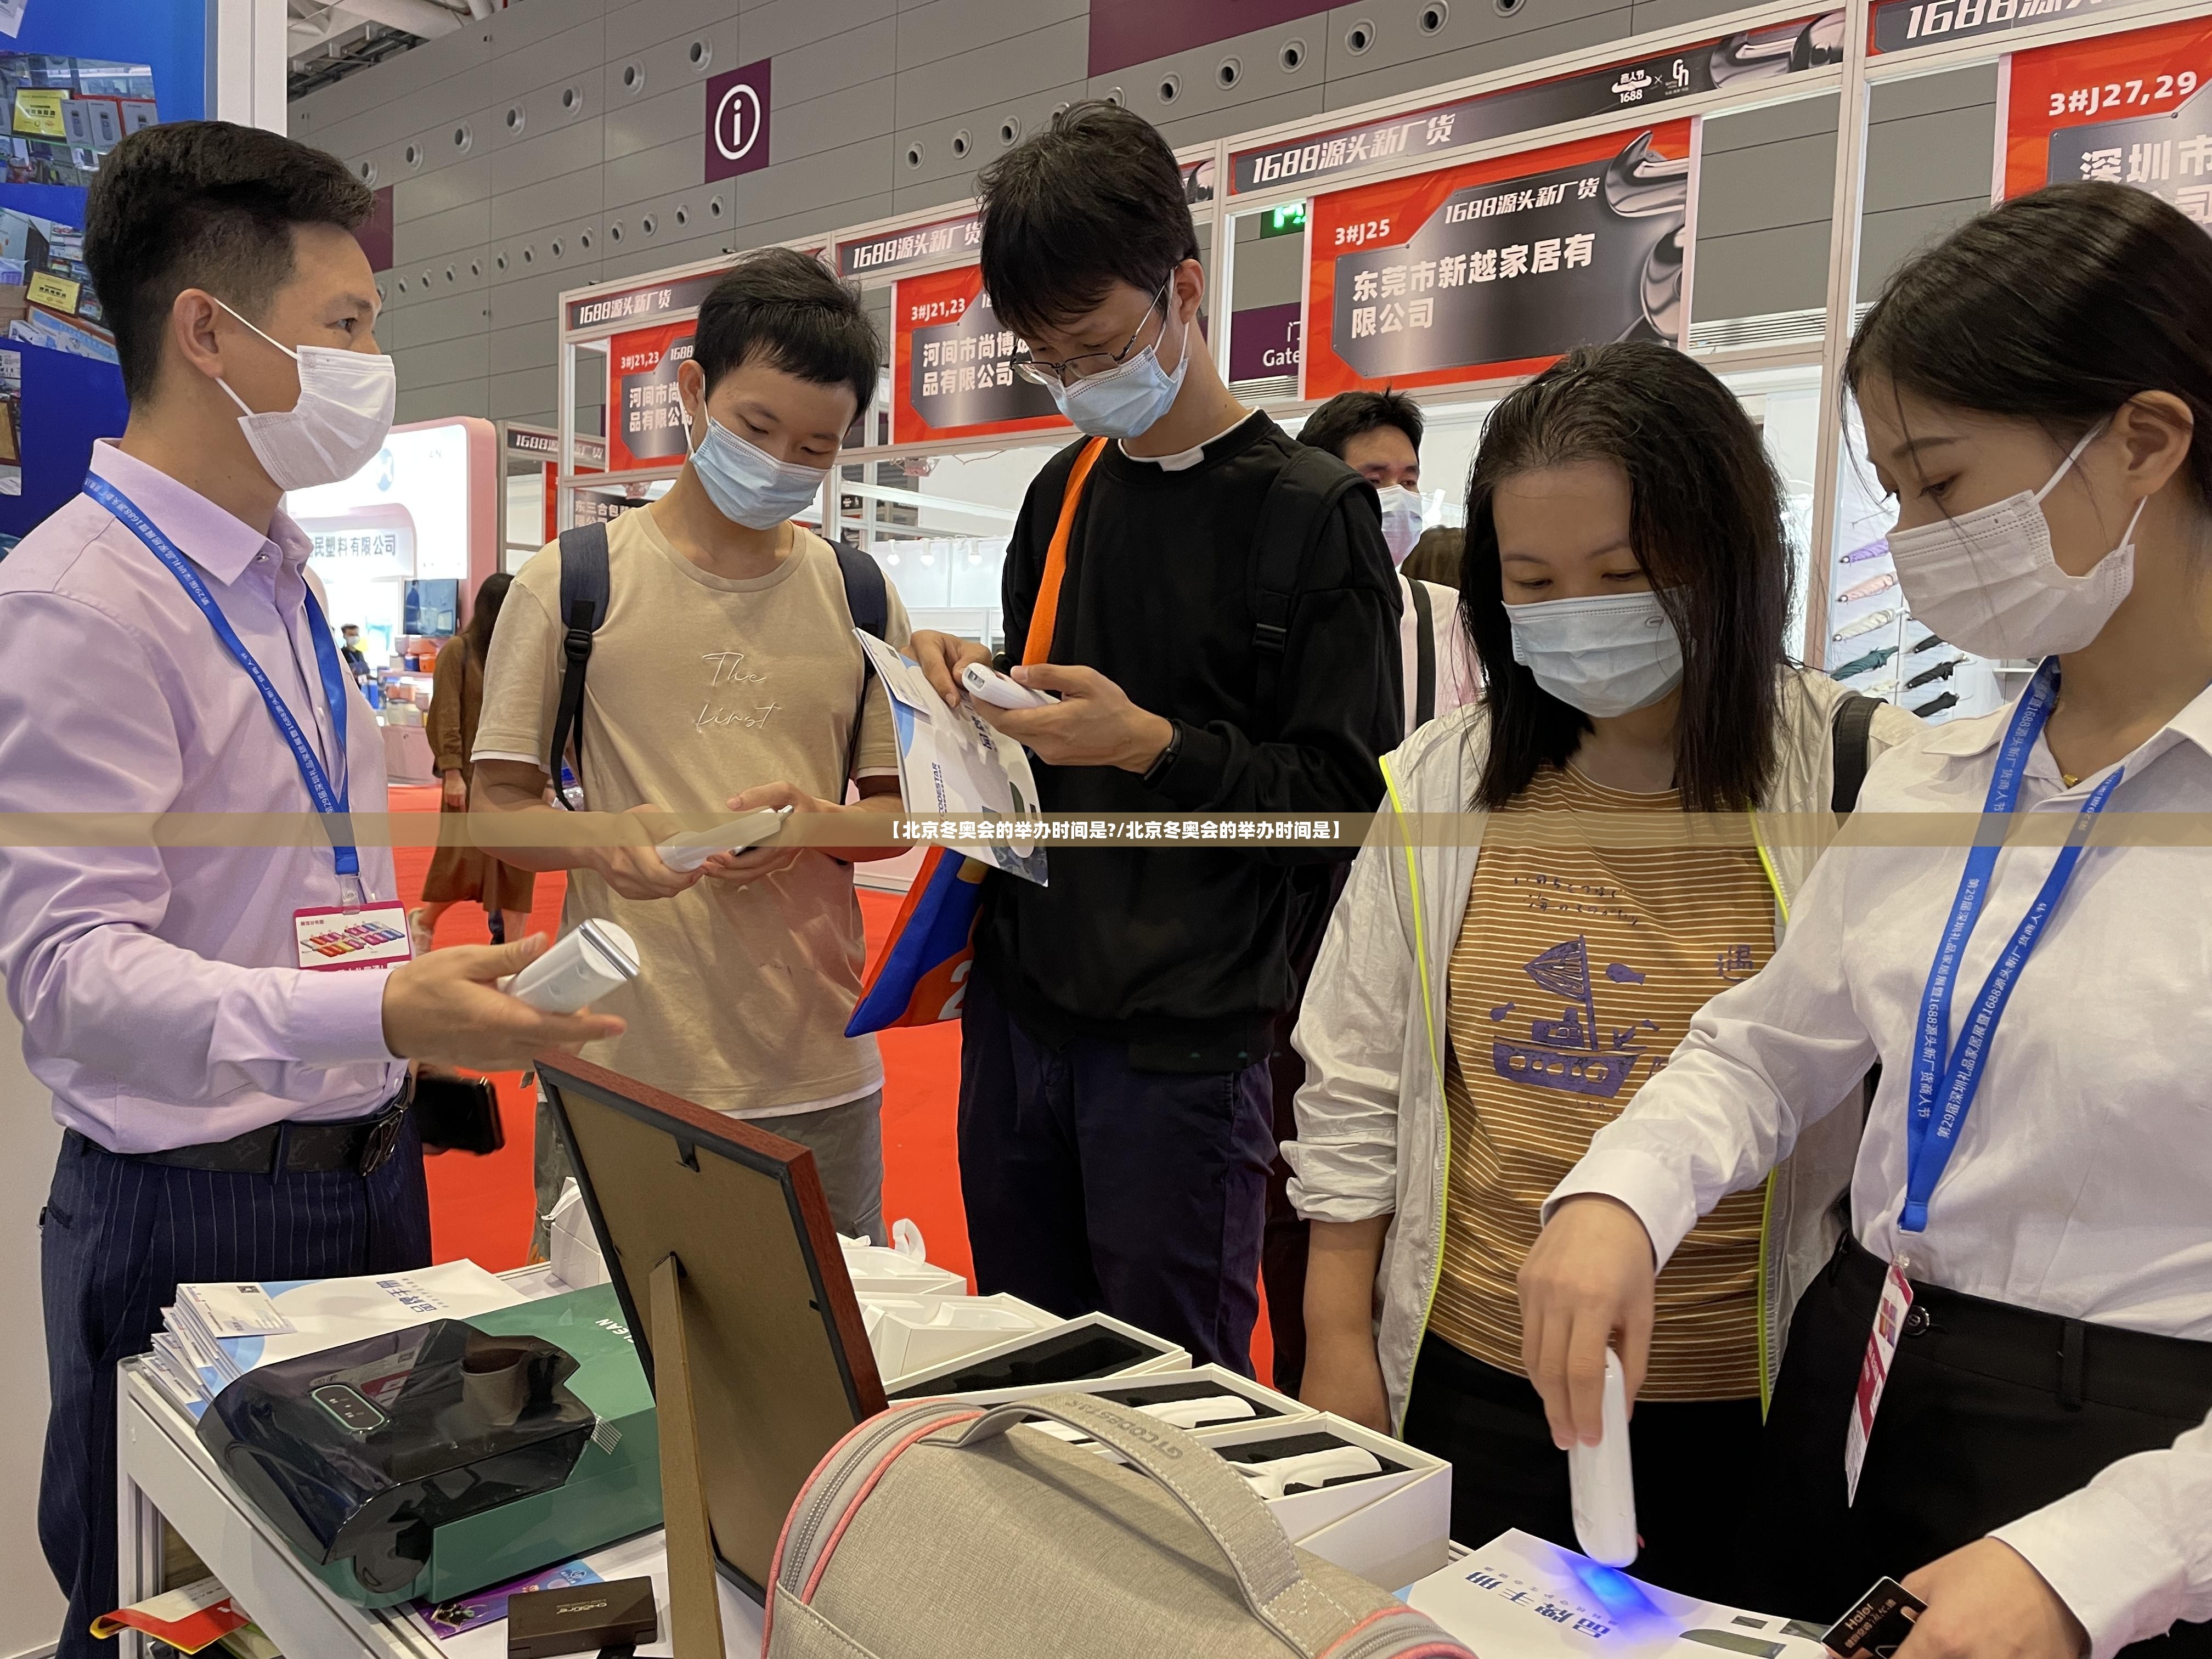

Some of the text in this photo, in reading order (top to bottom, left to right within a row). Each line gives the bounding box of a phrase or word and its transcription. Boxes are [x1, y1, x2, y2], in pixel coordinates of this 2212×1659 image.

[1620, 89, 1643, 103] 1688
[2049, 71, 2197, 116] 3#J27,29
[1253, 113, 1455, 183] 1688源头新厂货
[2080, 134, 2212, 184] 深圳市
[1445, 177, 1600, 224] 1688源头新厂货
[853, 222, 984, 269] 1688源头新厂货
[1335, 219, 1390, 246] 3#J25
[1352, 233, 1596, 302] 东莞市新越家居有
[579, 289, 672, 325] 1688源头新厂货
[911, 298, 966, 323] 3#J21,23
[1351, 297, 1434, 339] 限公司
[620, 351, 659, 370] 3#J21,23
[1263, 347, 1301, 368] Gate
[923, 360, 1014, 397] 品有限公司
[309, 534, 396, 558] 民塑料有限公司
[702, 651, 767, 686] The
[694, 702, 782, 733] first
[595, 1318, 634, 1344] EAN
[1464, 1570, 1612, 1639] 品牌手册
